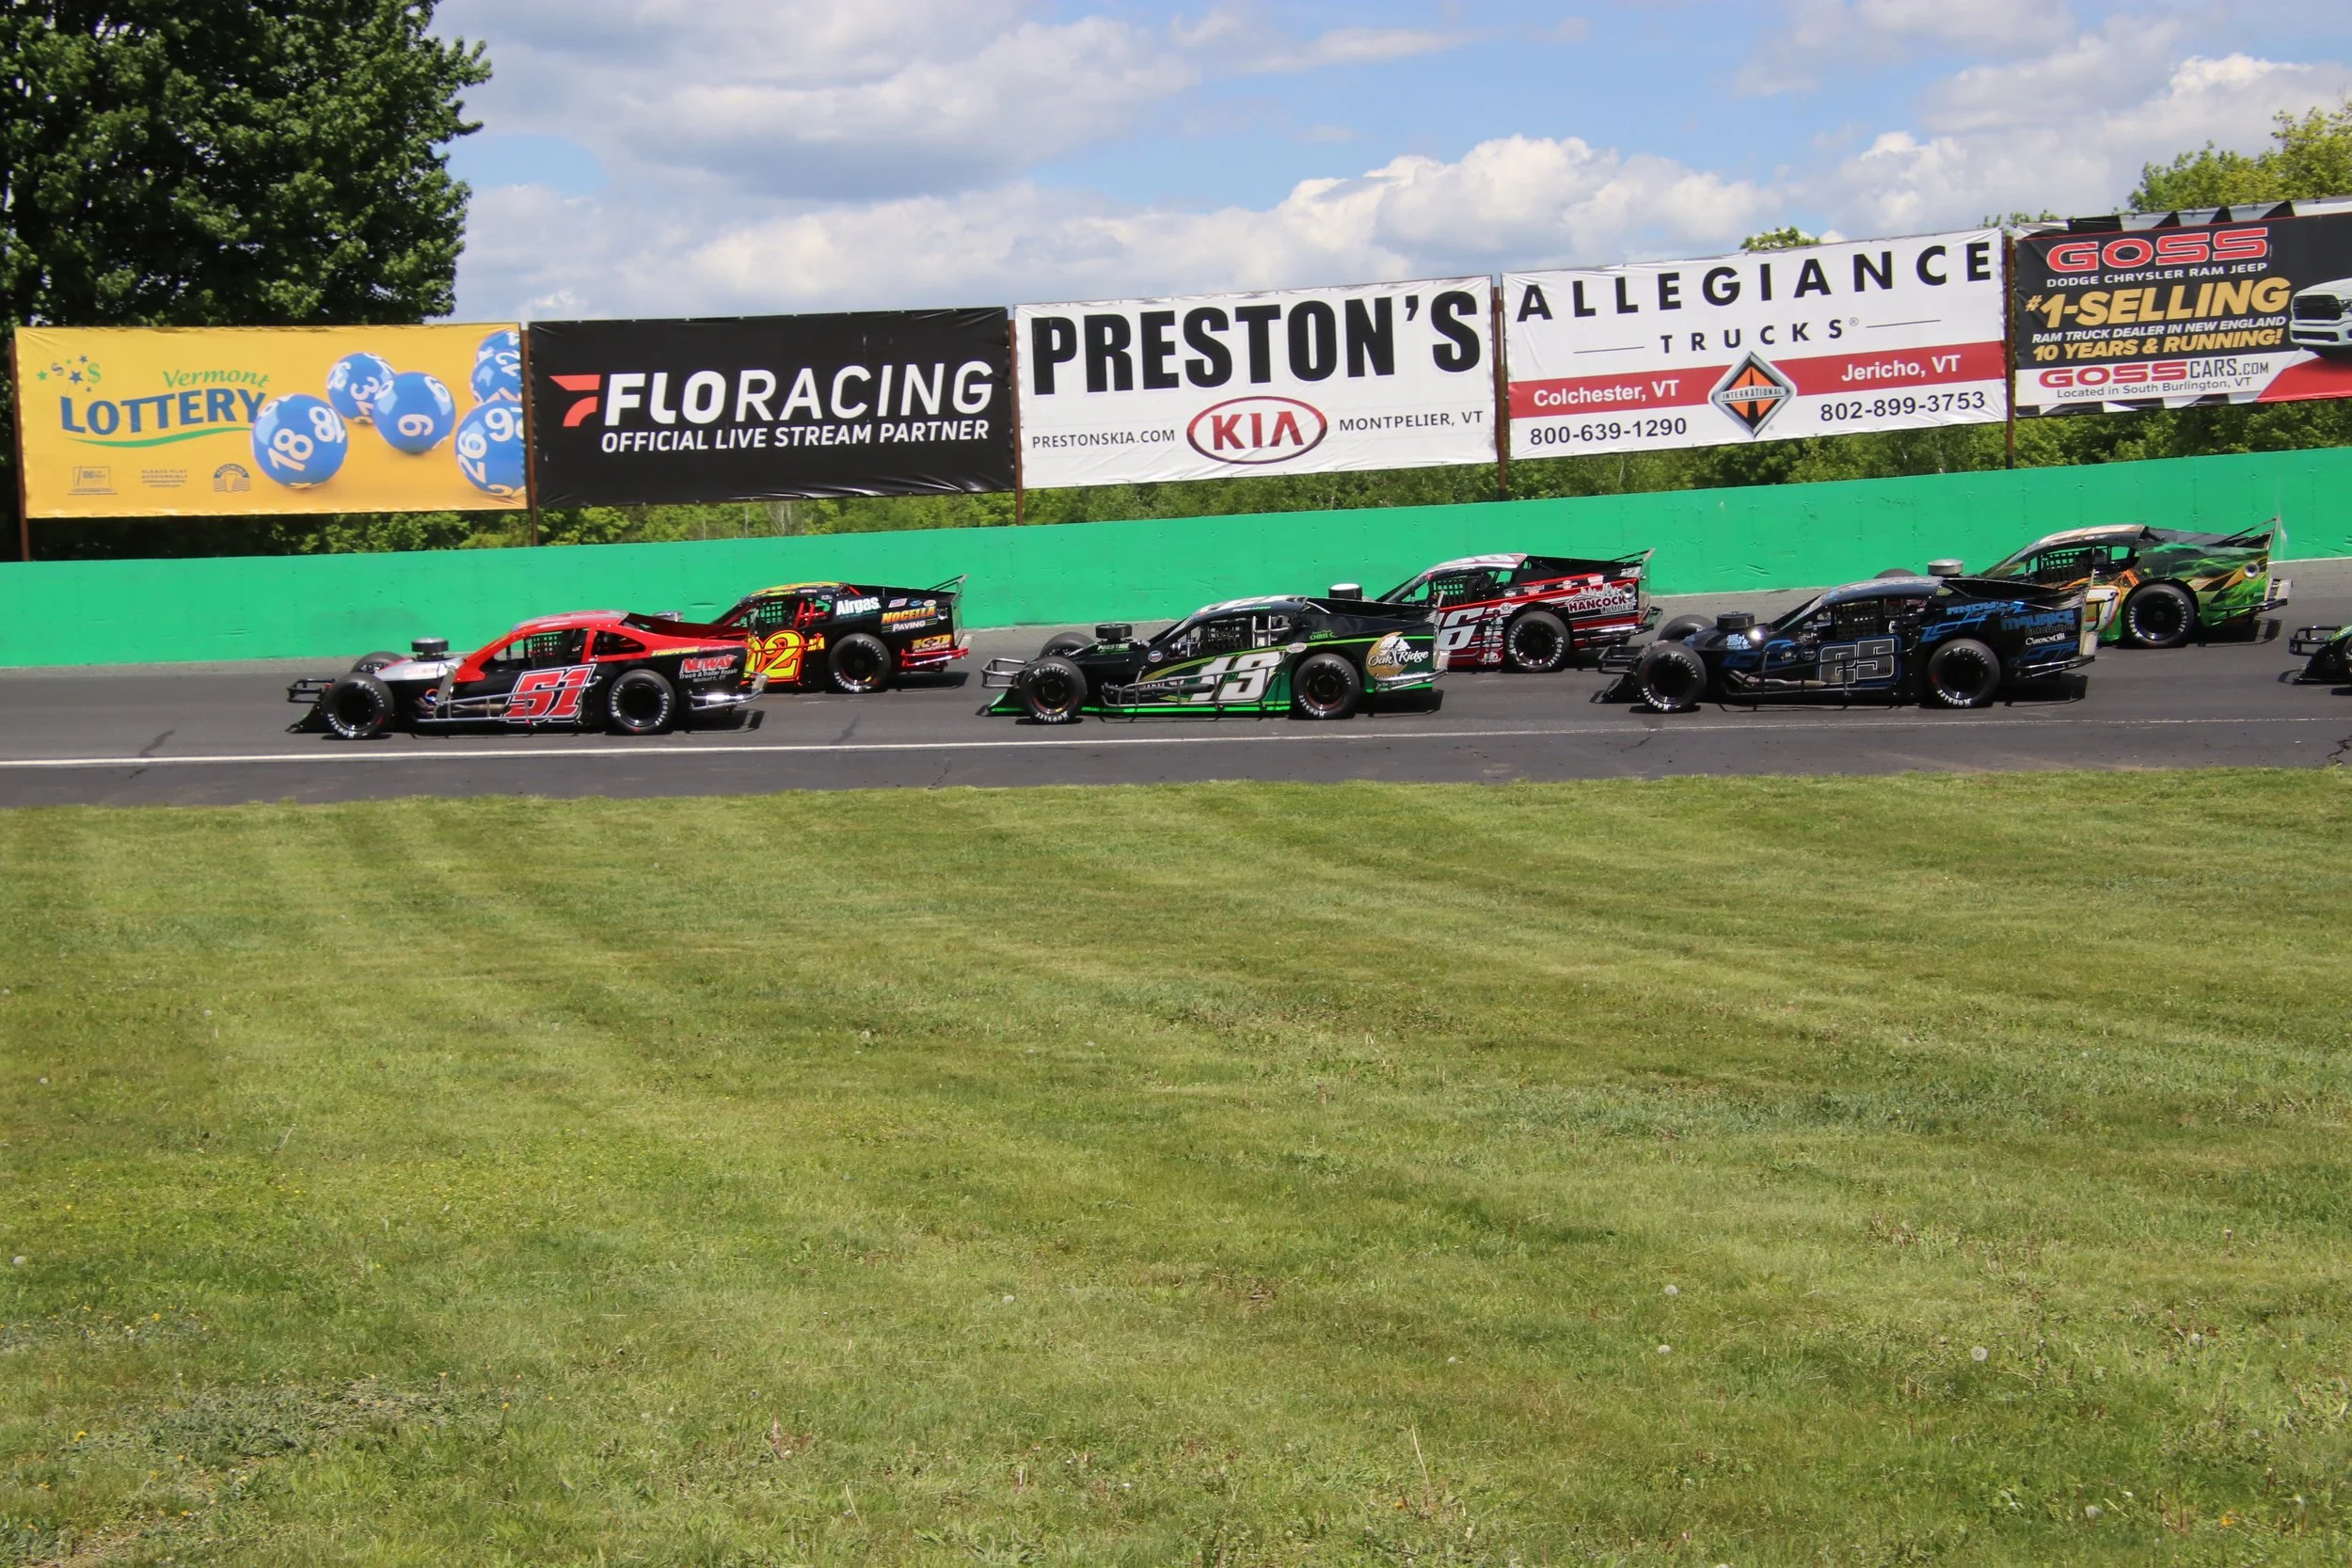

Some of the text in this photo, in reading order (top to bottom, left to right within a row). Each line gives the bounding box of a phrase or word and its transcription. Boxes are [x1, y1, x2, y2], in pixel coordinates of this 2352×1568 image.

[2046, 227, 2268, 273] GOSS
[1517, 242, 1991, 323] ALLEGIANCE
[2046, 262, 2267, 288] DODGE CHRYSLER RAM JEEP
[2025, 277, 2292, 329] #1-SELLING
[1031, 291, 1481, 395] PRESTON'S
[2032, 316, 2286, 344] RAM TRUCK DEALER IN NEW ENGLAND
[2032, 327, 2284, 361] 10 YEARS & RUNNING!
[163, 368, 271, 388] Vermont
[1840, 355, 1962, 383] Jericho, VT
[604, 360, 993, 426] FLORACING
[1534, 380, 1679, 407] Colchester, VT
[1722, 387, 1782, 400] INTERNATIONAL
[2057, 376, 2251, 399] Located in South Burlington, VT
[60, 388, 267, 436] LOTTERY
[1820, 390, 1986, 422] 802-899-3753
[1210, 411, 1305, 451] KIA
[1339, 411, 1484, 433] MONTPELIER, VT
[1530, 417, 1688, 446] 800-639-1290
[267, 428, 313, 471] 18
[601, 420, 990, 453] OFFICIAL LIVE STREAM PARTNER
[1032, 430, 1176, 450] PRESTONSKIA.COM
[836, 596, 881, 616] Airgas
[882, 606, 936, 625] NOCELLA
[1569, 596, 1627, 612] HANCOCK
[892, 621, 926, 632] PAVING
[1368, 650, 1429, 666] Oak Ridge
[504, 663, 596, 722] 51
